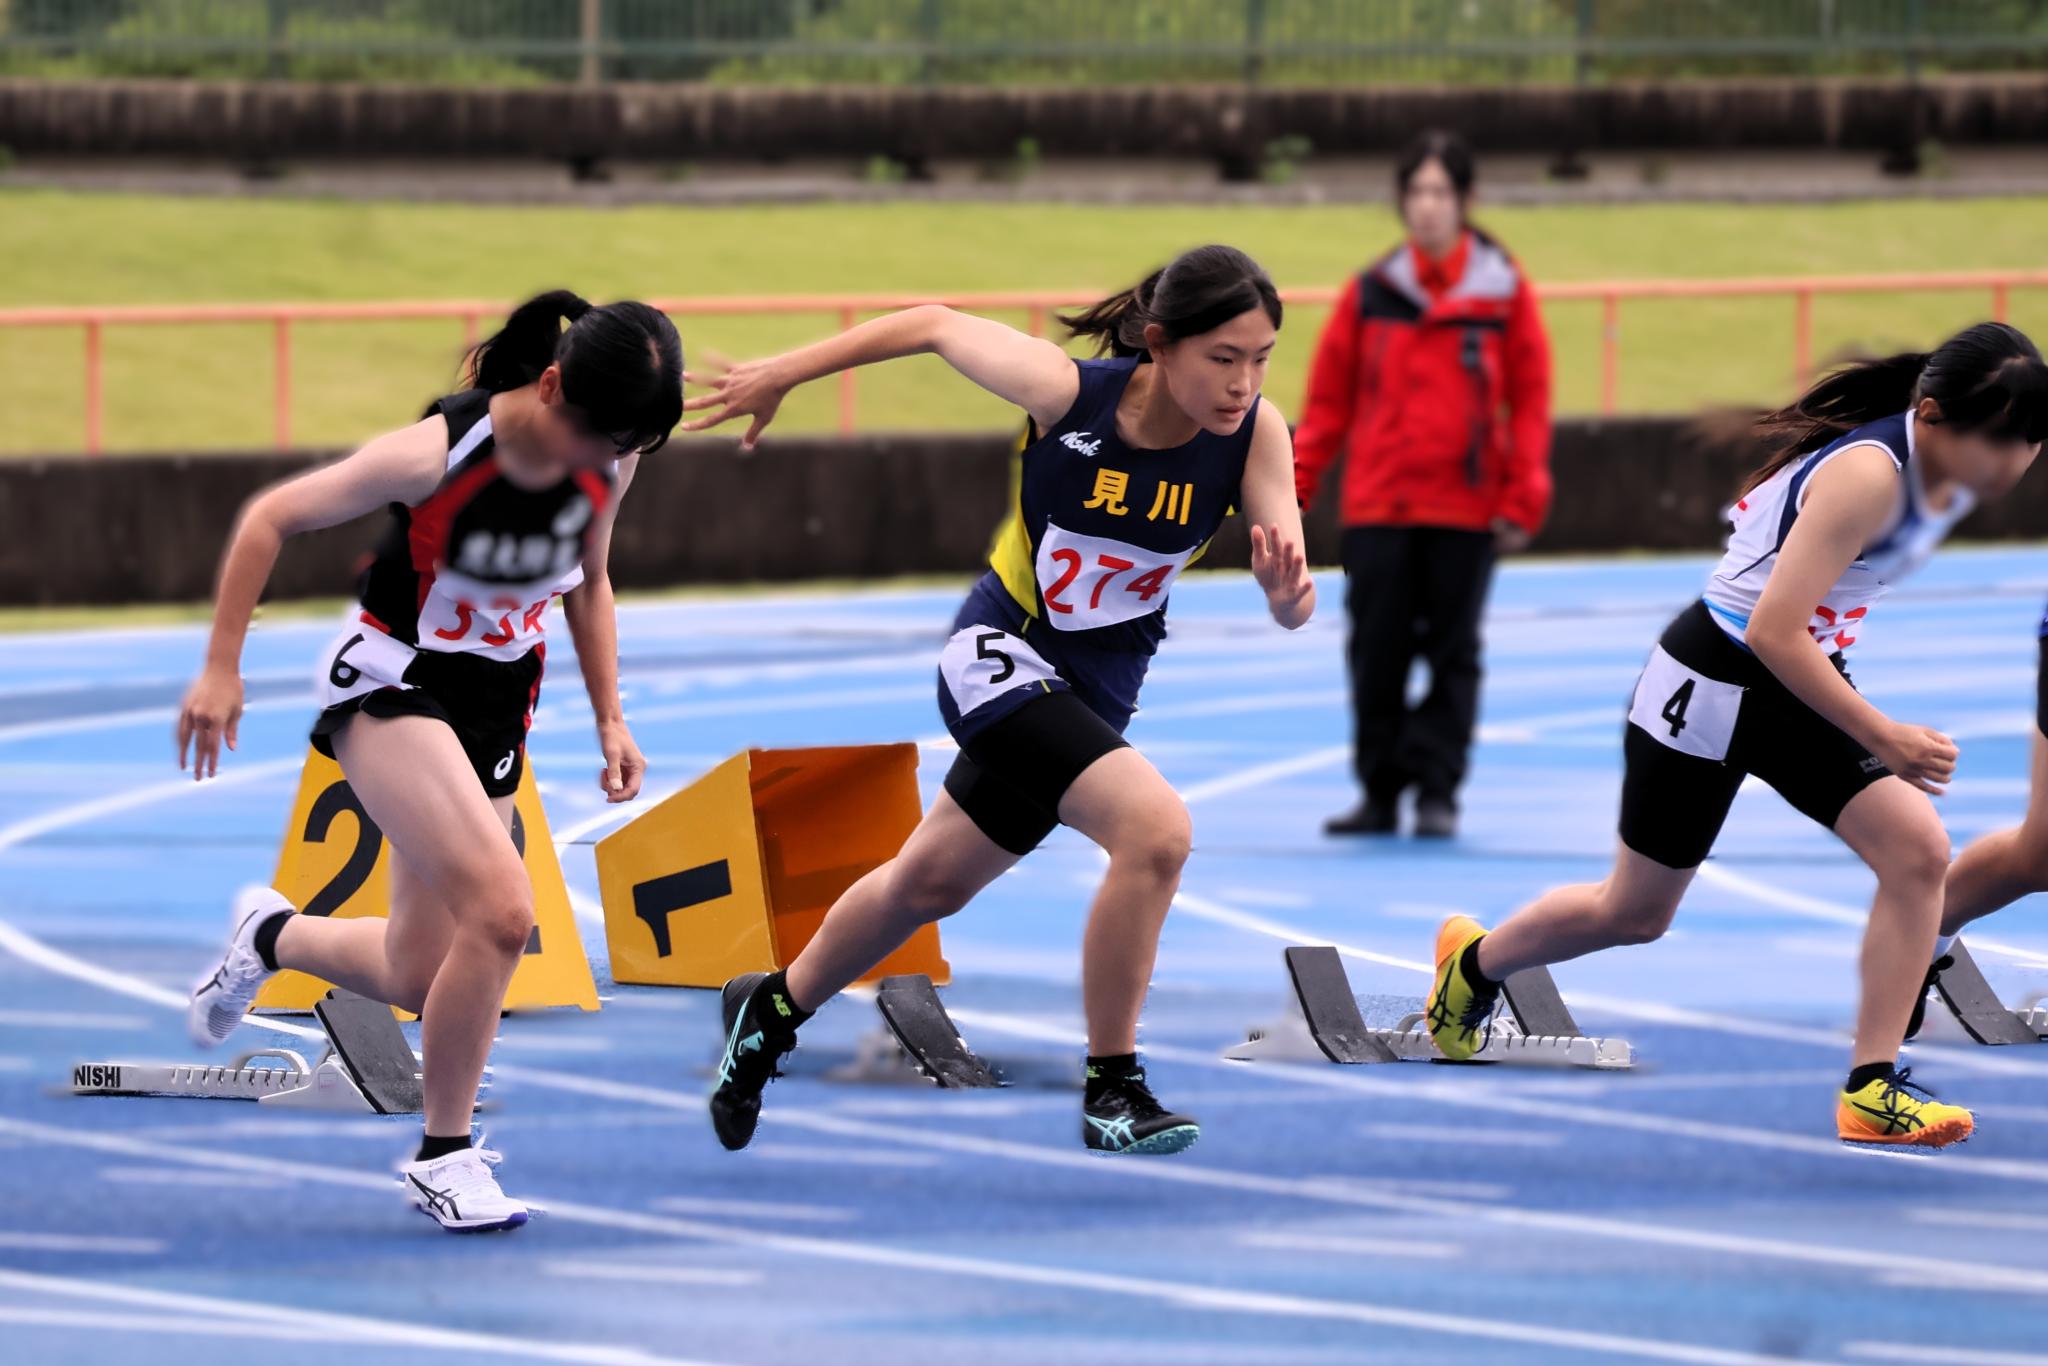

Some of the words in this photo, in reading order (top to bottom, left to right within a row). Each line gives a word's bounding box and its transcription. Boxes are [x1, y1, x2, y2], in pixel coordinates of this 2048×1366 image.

[1083, 467, 1193, 526] 見川
[1044, 548, 1174, 614] 274
[329, 633, 365, 689] 6
[976, 631, 1015, 684] 5
[1661, 678, 1696, 738] 4
[303, 779, 383, 918] 2
[632, 858, 733, 959] 1
[74, 1064, 121, 1088] NISHI
